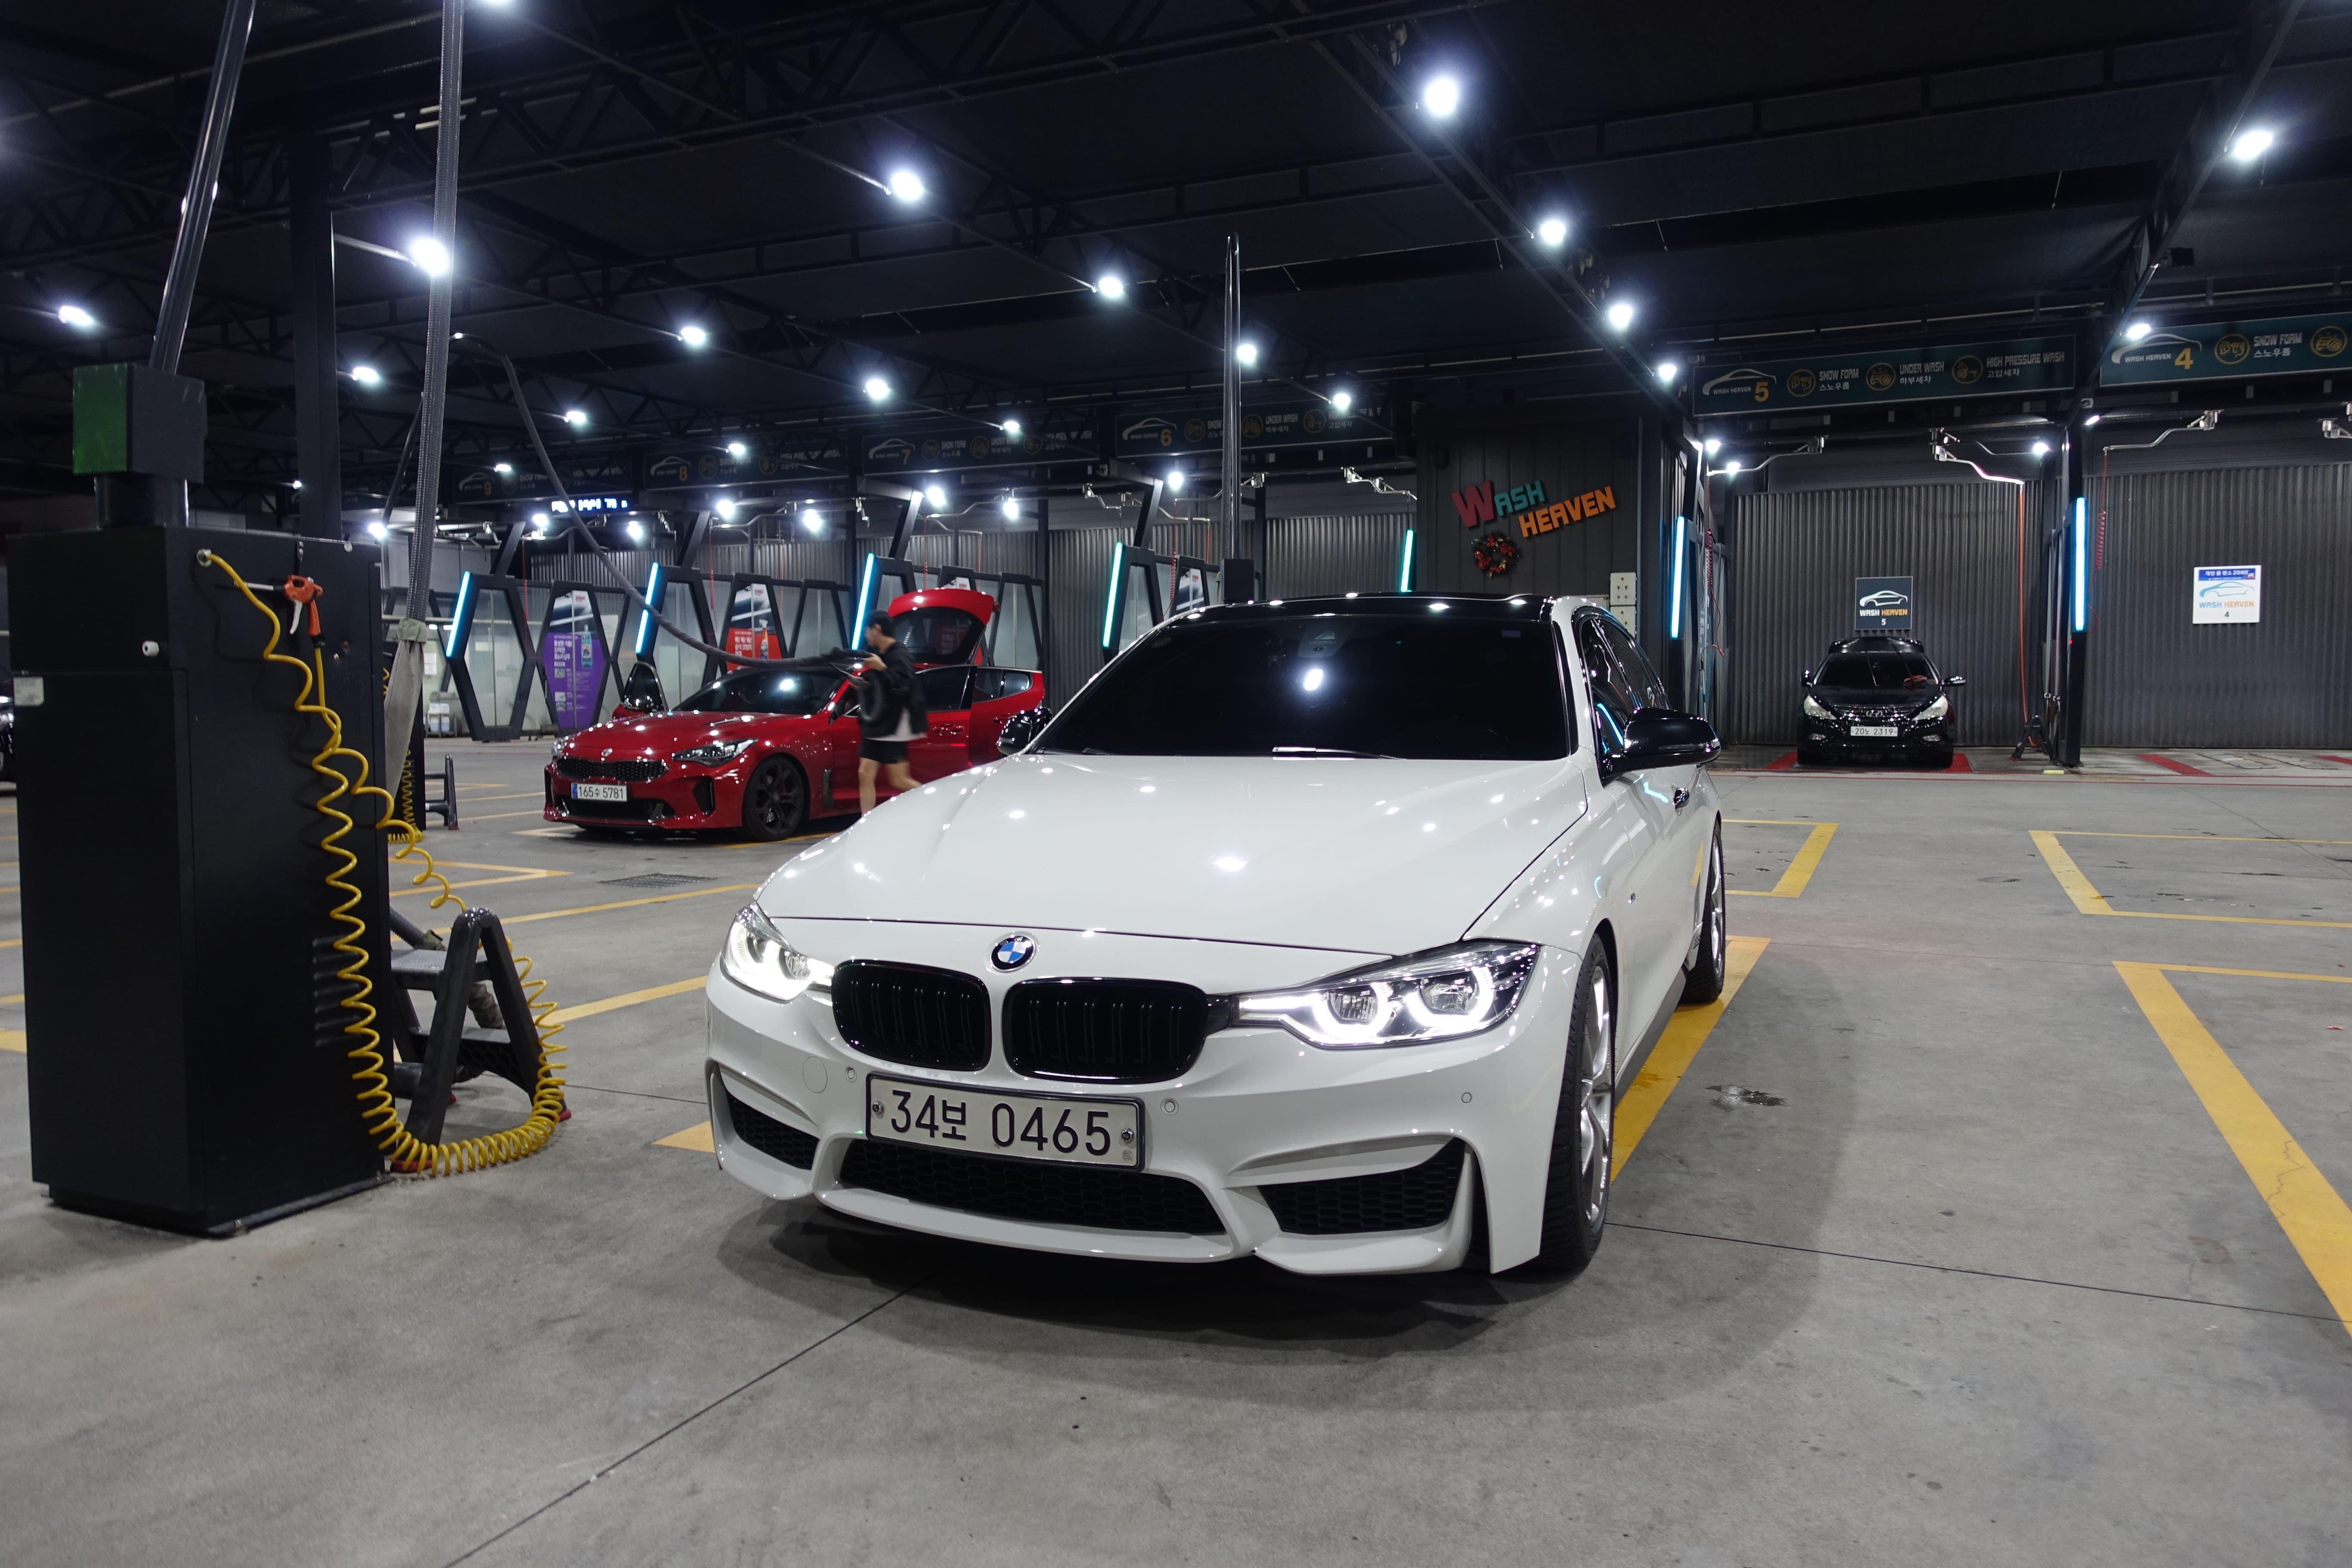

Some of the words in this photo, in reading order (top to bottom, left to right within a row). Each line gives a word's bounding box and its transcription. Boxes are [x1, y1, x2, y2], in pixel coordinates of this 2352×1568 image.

[2254, 335, 2277, 346] SNOW
[2279, 332, 2303, 345] FOAM
[1986, 356, 2003, 368] HIGH
[2004, 353, 2041, 366] PRESSURE
[2043, 351, 2065, 364] WASH
[2174, 347, 2194, 370] 4
[1819, 370, 1839, 381] SNOW
[1841, 368, 1860, 379] FOAM
[1899, 364, 1921, 375] UNDER
[1923, 361, 1945, 373] WASH
[1899, 375, 1932, 385] 하부세차
[1754, 381, 1770, 402] 5
[1160, 428, 1173, 447] 6
[901, 448, 911, 466] 7
[678, 465, 688, 482] 8
[1451, 479, 1546, 528] WASH
[1518, 485, 1617, 538] HEAVEN
[579, 786, 600, 797] 165수
[603, 787, 623, 799] 5781
[891, 1089, 967, 1141] 34보
[992, 1102, 1111, 1156] 0465
